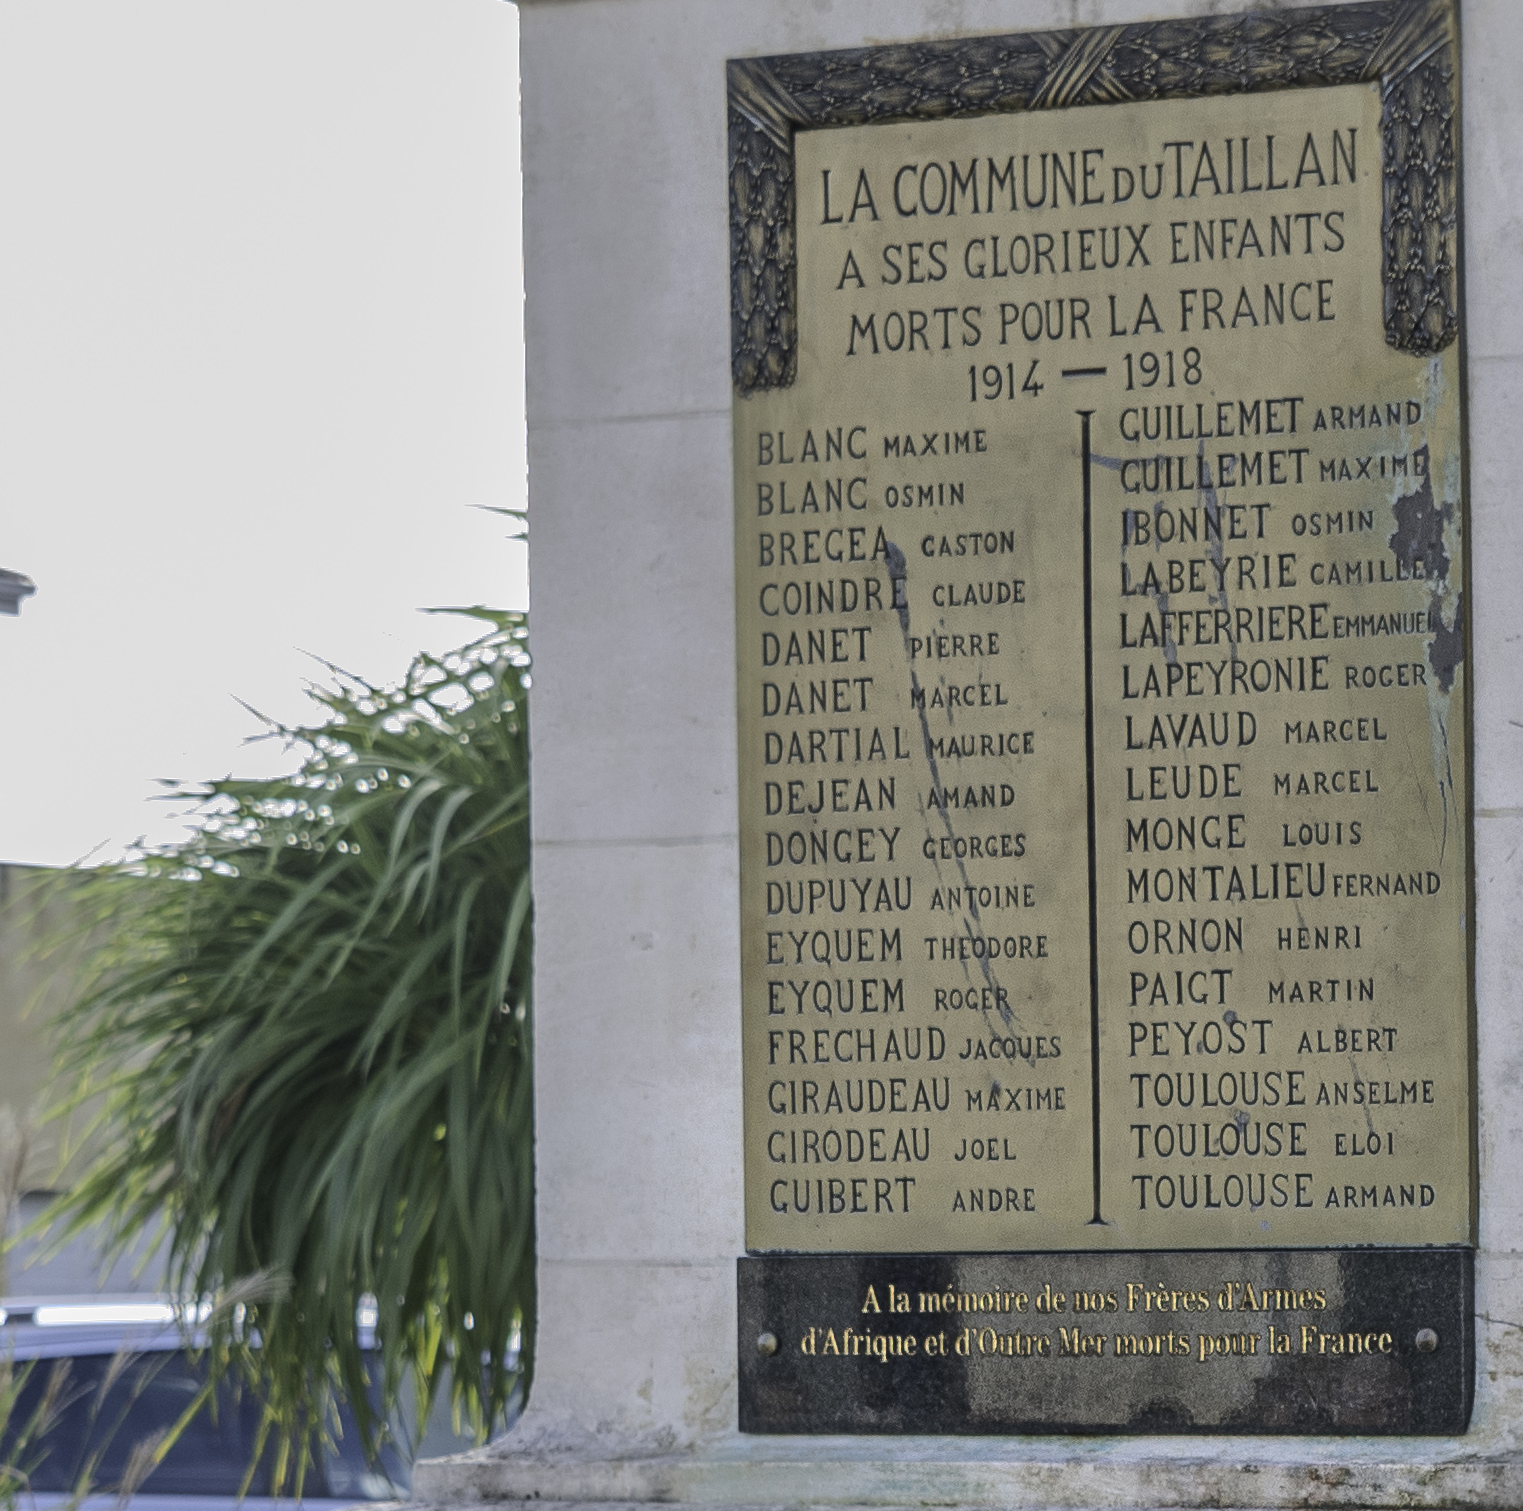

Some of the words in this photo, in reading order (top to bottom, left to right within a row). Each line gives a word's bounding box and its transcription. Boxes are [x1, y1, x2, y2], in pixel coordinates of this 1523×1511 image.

[820, 169, 880, 224] LA
[893, 149, 1105, 217] COMMUNE
[1164, 128, 1359, 198] TAILLAN
[836, 250, 865, 289] A
[881, 240, 948, 285] SES
[964, 223, 1151, 279] GLORIEUX
[1170, 211, 1345, 264] ENFANTS
[846, 306, 982, 355] MORTS
[999, 298, 1091, 344] POUR
[1109, 293, 1163, 336] LA
[1180, 279, 1337, 332] FRANCE
[969, 360, 1044, 402] 1914
[1123, 346, 1203, 390] 1918
[1120, 397, 1304, 442] GUILLEMET
[1313, 400, 1422, 432] ARMAND
[758, 426, 867, 466] BLANC
[884, 430, 987, 458] MAXIME
[1120, 448, 1310, 493] GUILLEMET
[1319, 451, 1426, 482] MAXIME
[758, 477, 867, 516] BLANC
[885, 483, 964, 508] OSMIN
[1292, 510, 1374, 537] OSMIN
[758, 526, 891, 567] BREGEA
[921, 531, 1015, 558] GASTON
[1121, 553, 1297, 597] LABEYRIE
[1310, 557, 1426, 586] CAMILLE
[760, 576, 908, 617] COINDRE
[932, 580, 1026, 608] CLAUDE
[1119, 603, 1330, 649] LAFFERRIERE
[762, 627, 872, 666] DANET
[909, 632, 1000, 659] PIERRE
[762, 677, 873, 717] DANET
[910, 683, 1008, 710] MARCEL
[1122, 656, 1329, 700] LAPEYRONIE
[1345, 663, 1427, 689] ROGER
[764, 726, 910, 765] DARTIAL
[929, 731, 1035, 759] MAURICE
[1125, 711, 1258, 750] LAVAUD
[1285, 717, 1387, 744] MARCEL
[765, 777, 895, 816] DEJEAN
[927, 784, 1015, 809] AMAND
[1126, 763, 1242, 801] LEUDE
[1274, 769, 1379, 796] MARCEL
[765, 826, 900, 867] DONGEY
[923, 833, 1026, 860] GEORGES
[1126, 814, 1246, 852] MONGE
[1282, 820, 1362, 847] LOUIS
[766, 876, 912, 916] DUPUYAU
[930, 884, 1035, 910] ANTOINE
[1127, 862, 1326, 904] MONTALIEU
[1333, 871, 1441, 898] FERNAND
[766, 928, 903, 967] EYQUEM
[924, 935, 1049, 961] THEODORE
[1128, 917, 1243, 955] ORNON
[1277, 925, 1362, 950] HENRI
[768, 978, 905, 1018] EYQUEM
[934, 987, 1009, 1012] ROGER
[1268, 977, 1375, 1004] MARTIN
[768, 1026, 946, 1065] FRECHAUD
[958, 1036, 1061, 1062] JACQUES
[1129, 1019, 1273, 1057] PEYOST
[1297, 1027, 1397, 1053] ALBERT
[768, 1077, 950, 1115] GIRAUDEAU
[965, 1087, 1065, 1112] MAXIME
[1129, 1071, 1306, 1108] TOULOUSE
[1316, 1080, 1435, 1106] ANSELME
[767, 1127, 931, 1164] GIRODEAU
[954, 1138, 1017, 1161] JOEL
[1130, 1122, 1307, 1158] TOULOUSE
[1335, 1132, 1395, 1156] ELOI
[770, 1177, 915, 1214] GUIBERT
[952, 1188, 1036, 1212] ANDRE
[1132, 1173, 1314, 1211] TOULOUSE
[1324, 1184, 1435, 1209] ARMAND
[861, 1284, 882, 1314] A
[888, 1284, 912, 1314] la
[918, 1283, 1028, 1313] mémoire
[1036, 1284, 1066, 1313] de
[1074, 1289, 1118, 1313] nos
[1126, 1282, 1210, 1312] Frères
[1218, 1282, 1327, 1312] d'Armes
[800, 1326, 917, 1363] d'Afrique
[925, 1331, 949, 1357] et
[954, 1326, 1051, 1356] d'Outre
[1058, 1326, 1107, 1357] Mer
[1116, 1330, 1190, 1356] morts
[1199, 1332, 1262, 1363] pour
[1268, 1325, 1291, 1354] la
[1300, 1325, 1393, 1355] France
